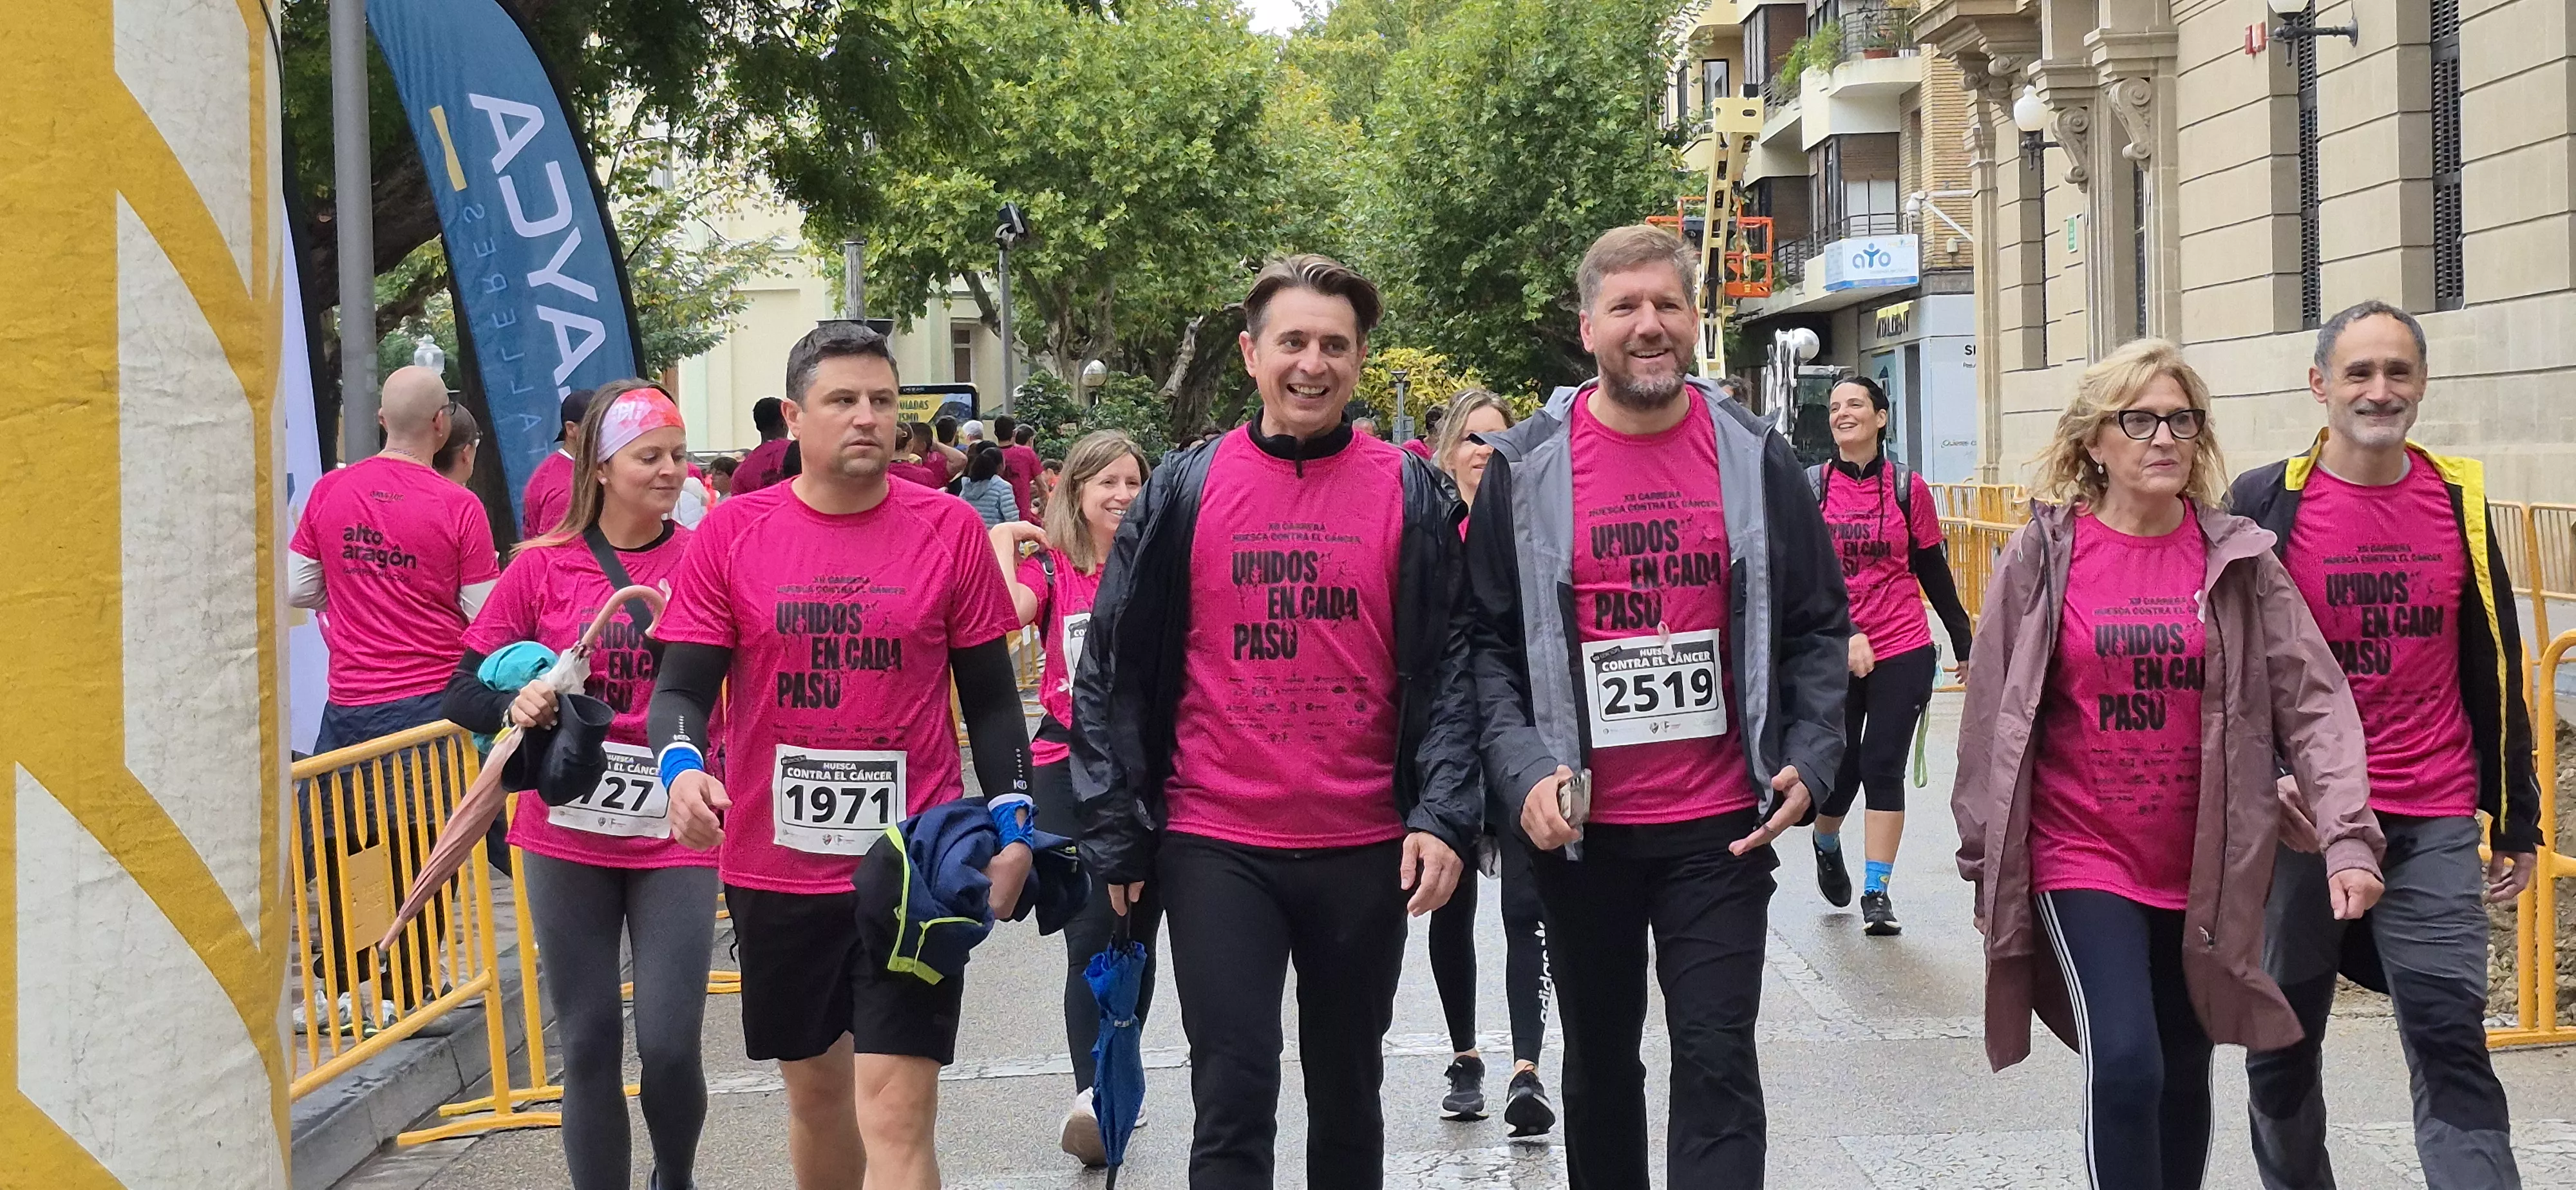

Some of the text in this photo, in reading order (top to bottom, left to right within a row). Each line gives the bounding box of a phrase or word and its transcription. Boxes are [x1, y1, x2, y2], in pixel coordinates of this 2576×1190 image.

[342, 524, 383, 545] alto
[1591, 518, 1679, 560] UNIDOS
[343, 543, 417, 569] aragón
[1233, 550, 1318, 585] UNIDOS
[1631, 552, 1721, 589] EN CADA
[1268, 586, 1359, 620] EN CADA
[2326, 571, 2409, 607] UNIDOS
[776, 602, 862, 634] UNIDOS
[1595, 590, 1662, 630] PASO
[2362, 606, 2389, 638] EN
[812, 637, 902, 670] EN CADA
[1233, 623, 1298, 660] PASO
[2096, 623, 2185, 657] UNIDOS
[609, 651, 634, 679] EN
[1602, 650, 1711, 672] CONTRA EL CÁNCER
[2134, 657, 2206, 690] EN CA
[777, 672, 840, 708] PASO
[1602, 668, 1713, 715] 2519
[2099, 693, 2166, 730] PASO
[614, 763, 625, 772] EL
[627, 763, 661, 775] CÁNC
[787, 768, 892, 780] CONTRA EL CÁNCER
[786, 784, 889, 824] 1971
